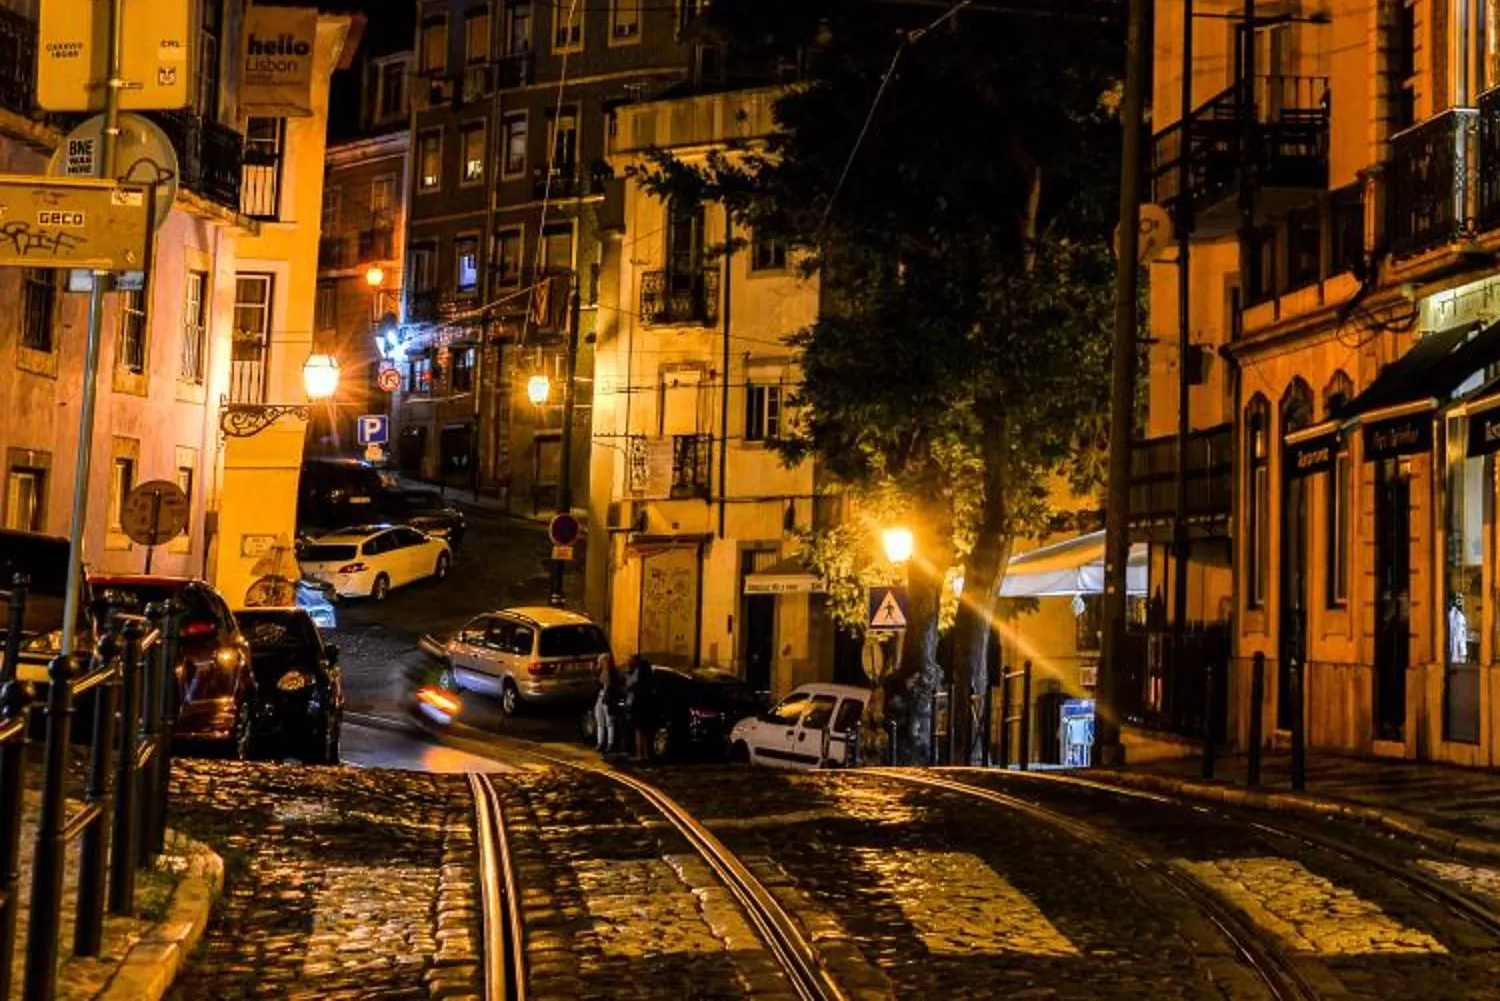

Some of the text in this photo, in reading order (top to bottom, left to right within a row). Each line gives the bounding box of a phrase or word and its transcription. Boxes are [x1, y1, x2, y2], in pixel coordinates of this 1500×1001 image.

[248, 32, 310, 56] hello
[246, 55, 298, 72] Lisbon
[364, 418, 382, 442] P
